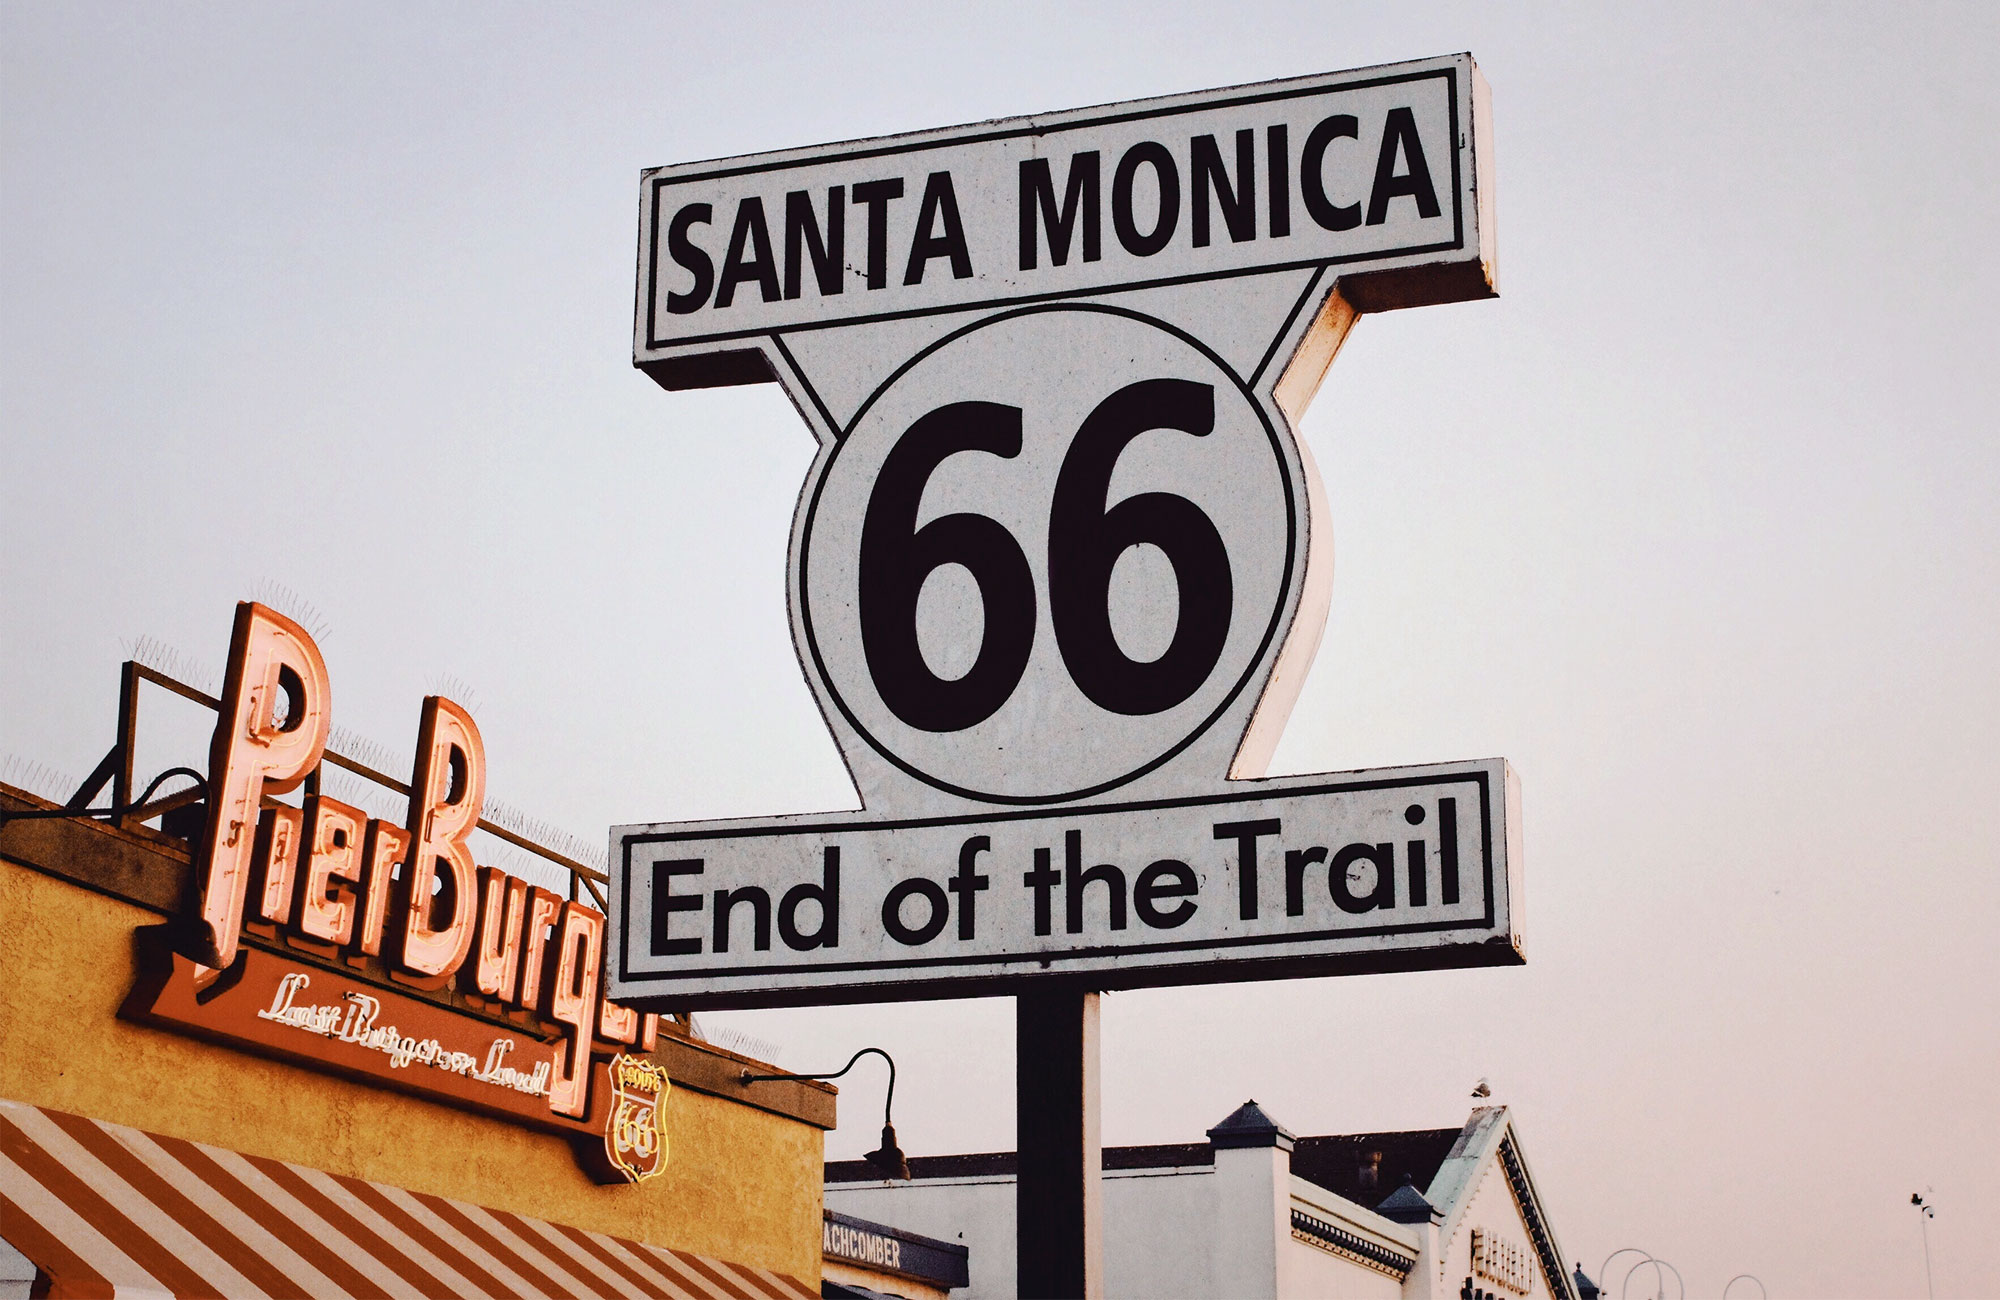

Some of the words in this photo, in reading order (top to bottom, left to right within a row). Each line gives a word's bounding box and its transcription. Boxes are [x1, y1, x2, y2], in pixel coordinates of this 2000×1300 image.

[667, 171, 974, 314] SANTA
[1019, 107, 1442, 271] MONICA
[859, 378, 1234, 733] 66
[651, 846, 840, 956] End
[882, 836, 990, 946] of
[1024, 830, 1199, 936] the
[1213, 798, 1460, 921] Trail
[614, 1101, 660, 1158] 66
